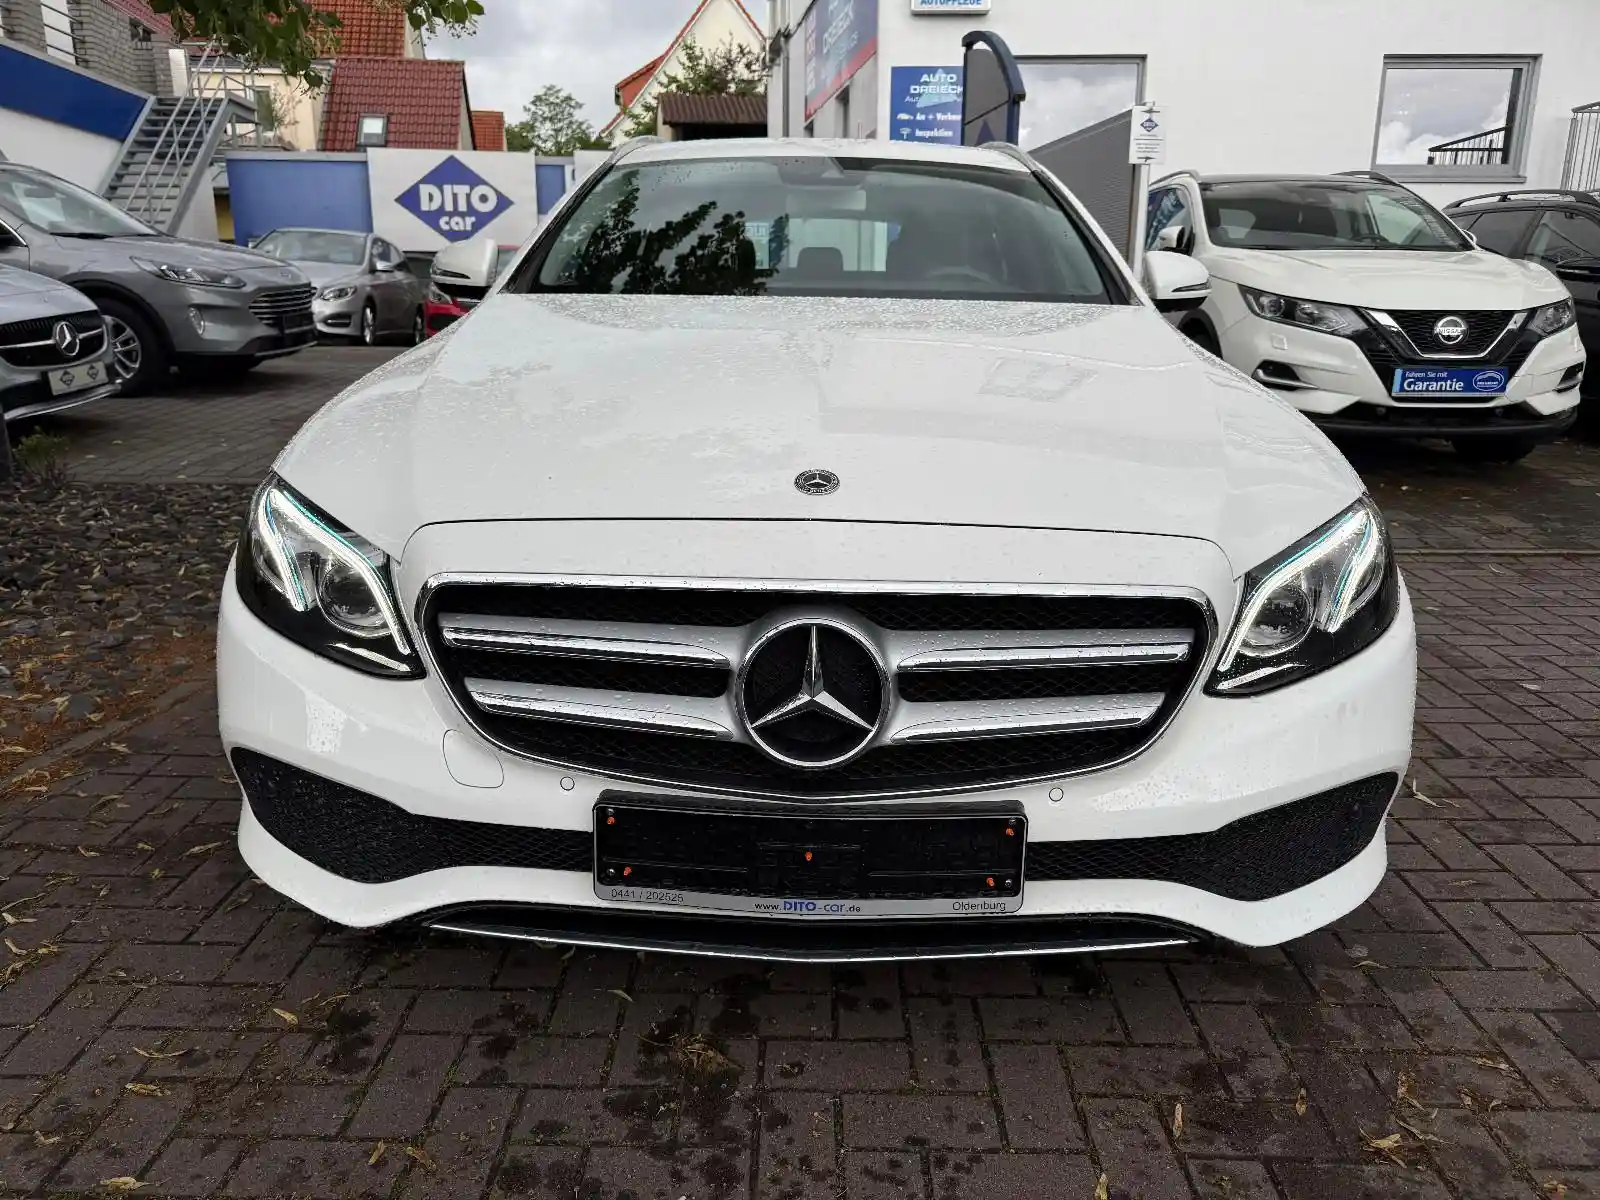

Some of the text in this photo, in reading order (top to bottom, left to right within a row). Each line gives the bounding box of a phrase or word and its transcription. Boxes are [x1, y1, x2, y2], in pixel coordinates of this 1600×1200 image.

[920, 73, 957, 82] AUTO
[936, 112, 962, 121] Verkau
[419, 184, 498, 213] DITO
[439, 216, 476, 231] car
[1403, 378, 1464, 391] Garantie
[611, 888, 636, 899] 0441
[646, 890, 684, 903] 202525
[754, 900, 861, 913] www.DITO-car.de
[952, 900, 1006, 912] Oldenburg
